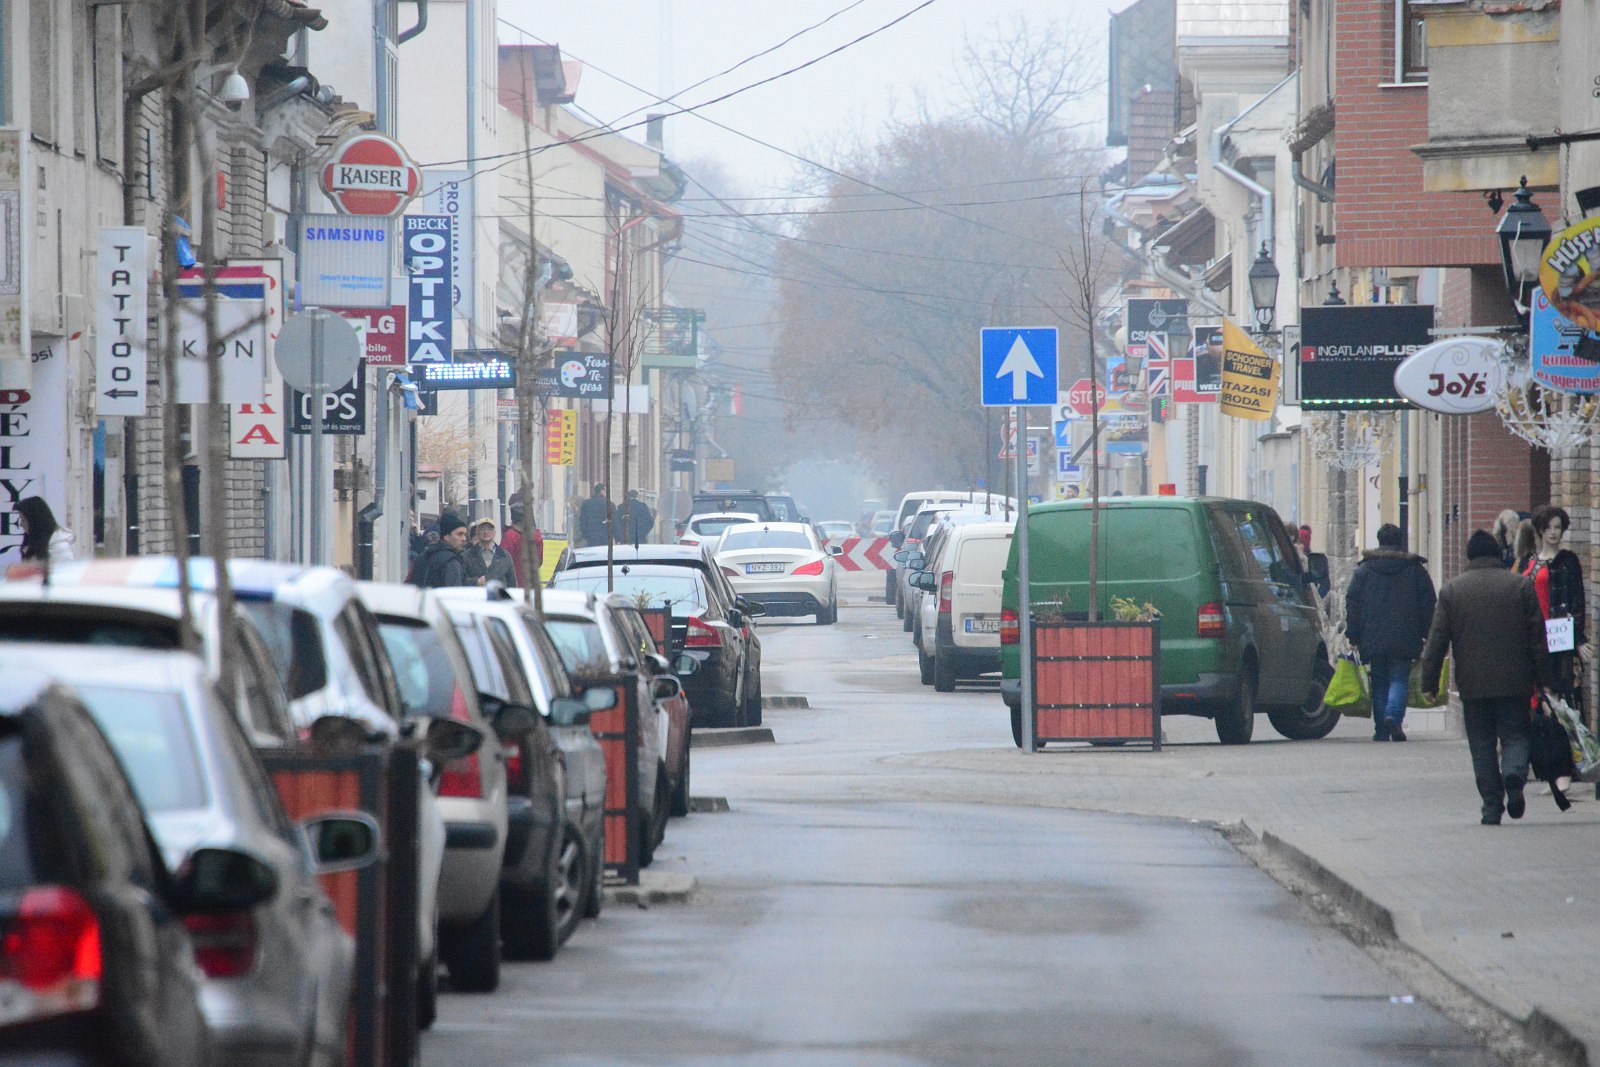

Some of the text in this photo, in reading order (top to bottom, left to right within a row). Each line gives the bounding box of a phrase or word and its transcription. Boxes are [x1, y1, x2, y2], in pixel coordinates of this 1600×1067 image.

[340, 167, 402, 187] KAISER
[407, 218, 448, 230] BECK
[306, 228, 385, 241] SAMSUNG
[409, 233, 447, 361] OPTIKA
[111, 245, 131, 381] TATTOO
[365, 315, 396, 334] LG
[366, 343, 387, 352] bile
[366, 353, 392, 363] pont
[1226, 351, 1271, 368] SCHOONER
[1232, 362, 1263, 376] TRAVEL
[1071, 391, 1103, 402] STOP
[751, 563, 784, 571] NYZ-392
[1547, 624, 1568, 634] CIÓ
